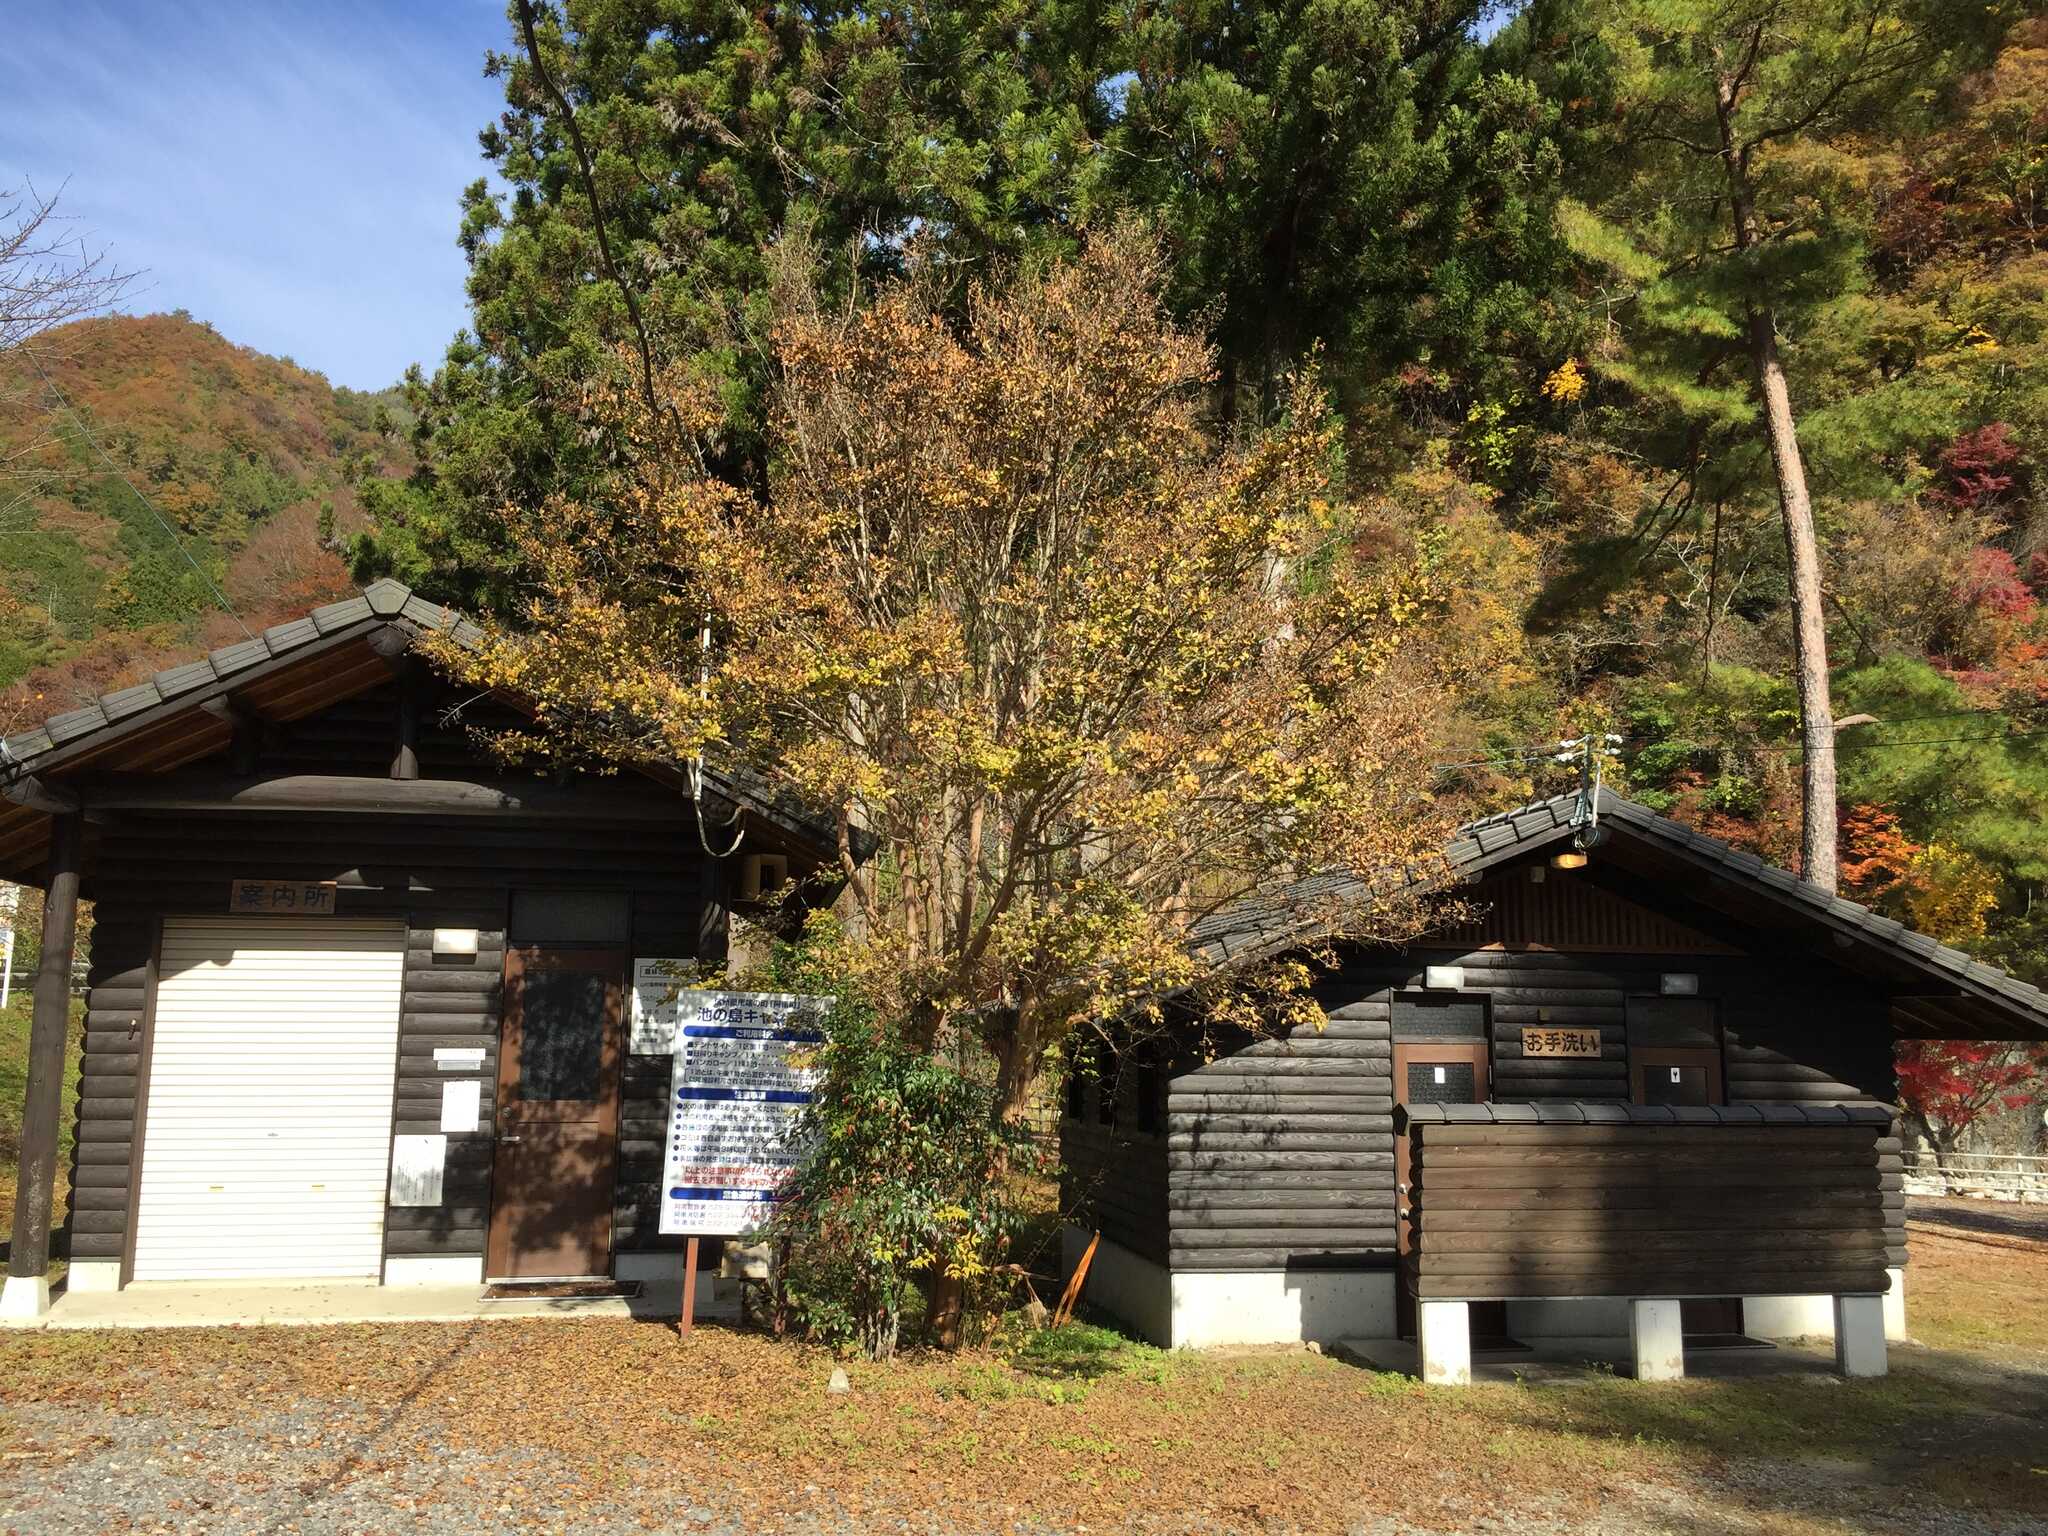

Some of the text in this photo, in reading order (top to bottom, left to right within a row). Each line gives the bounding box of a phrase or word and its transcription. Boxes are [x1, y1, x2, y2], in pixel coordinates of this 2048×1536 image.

[241, 884, 329, 908] 案内所
[1525, 1032, 1597, 1052] お手洗い
